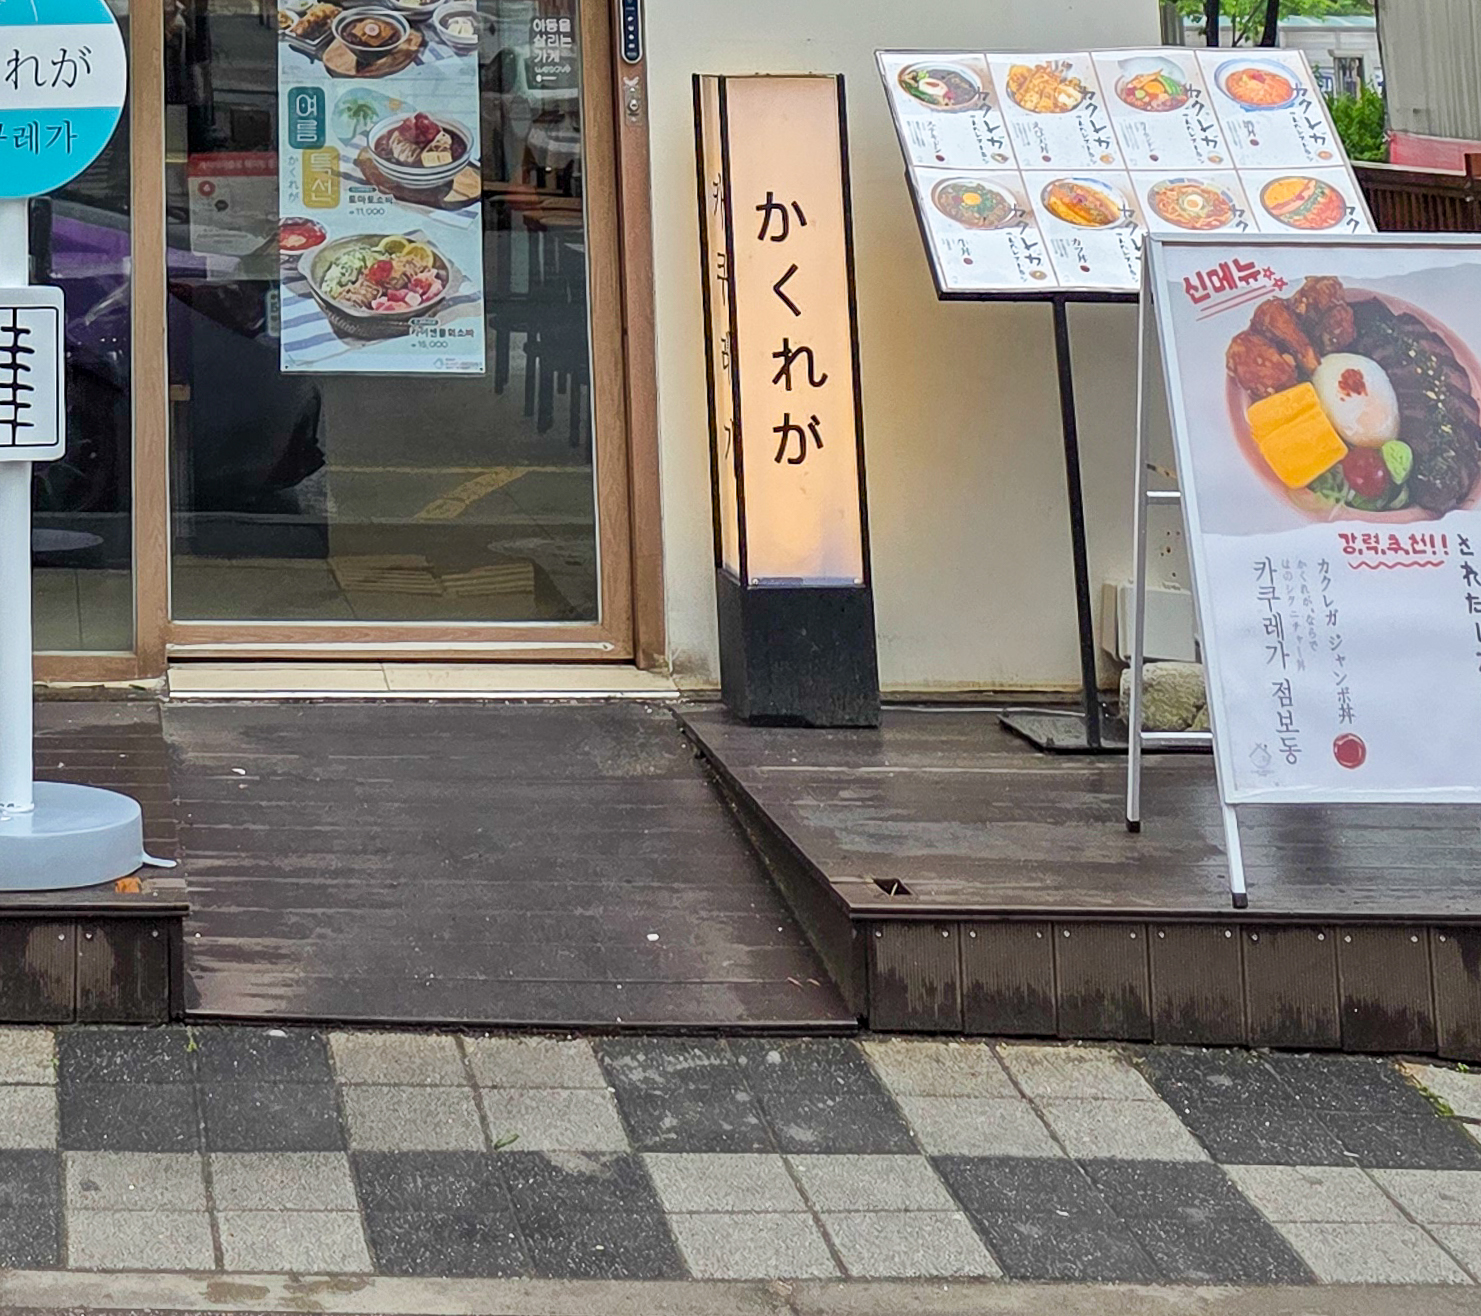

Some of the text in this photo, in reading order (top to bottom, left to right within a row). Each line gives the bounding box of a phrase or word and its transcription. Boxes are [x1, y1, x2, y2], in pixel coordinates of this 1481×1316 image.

[295, 94, 318, 142] 여름
[310, 153, 332, 201] 특선
[755, 191, 828, 465] かくれが
[1183, 257, 1260, 305] 신메뉴
[1253, 556, 1302, 765] 카쿠레가 점보동
[1318, 558, 1356, 724] カクレガ ジャンボ丼
